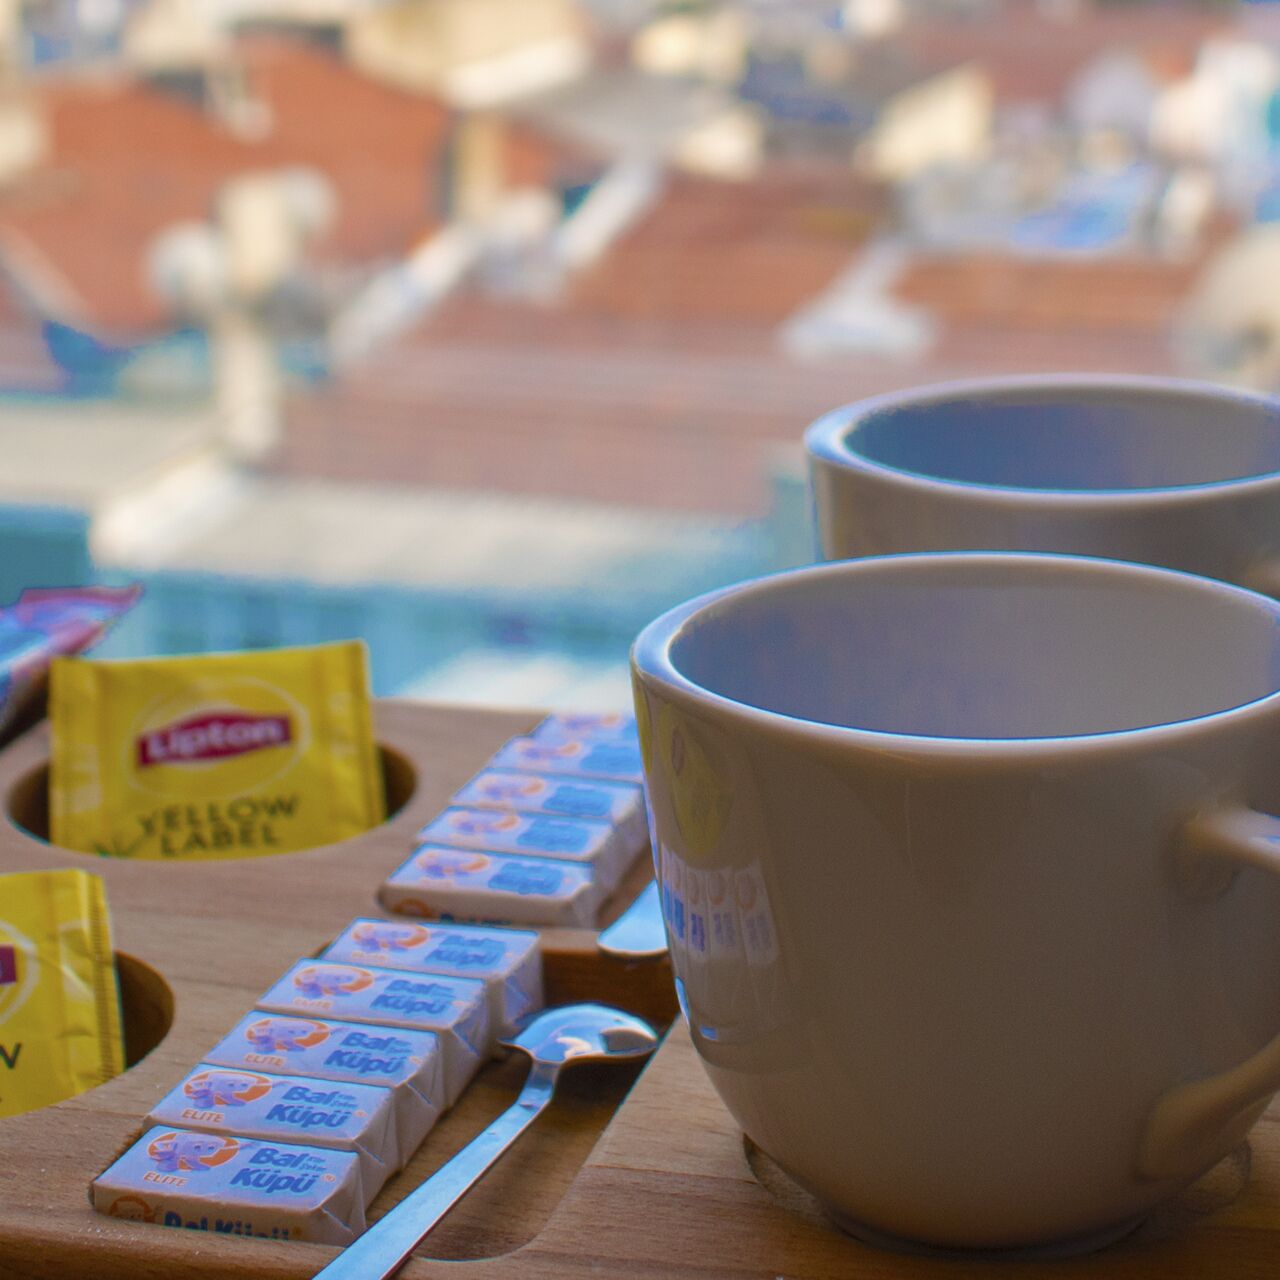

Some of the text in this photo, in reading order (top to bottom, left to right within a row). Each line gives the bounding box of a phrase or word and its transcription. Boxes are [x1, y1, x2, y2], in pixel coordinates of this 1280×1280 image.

[147, 719, 283, 760] Lipton
[138, 796, 299, 836] YELLOW
[161, 823, 282, 857] LABEL
[340, 1032, 397, 1051] Bal
[323, 1049, 407, 1073] Küpü
[282, 1086, 339, 1107] Bal
[181, 1108, 225, 1123] ELITE
[265, 1103, 352, 1128] Küpü
[249, 1148, 310, 1168] Bal
[143, 1171, 190, 1187] ELITE
[230, 1168, 320, 1194] Küpü
